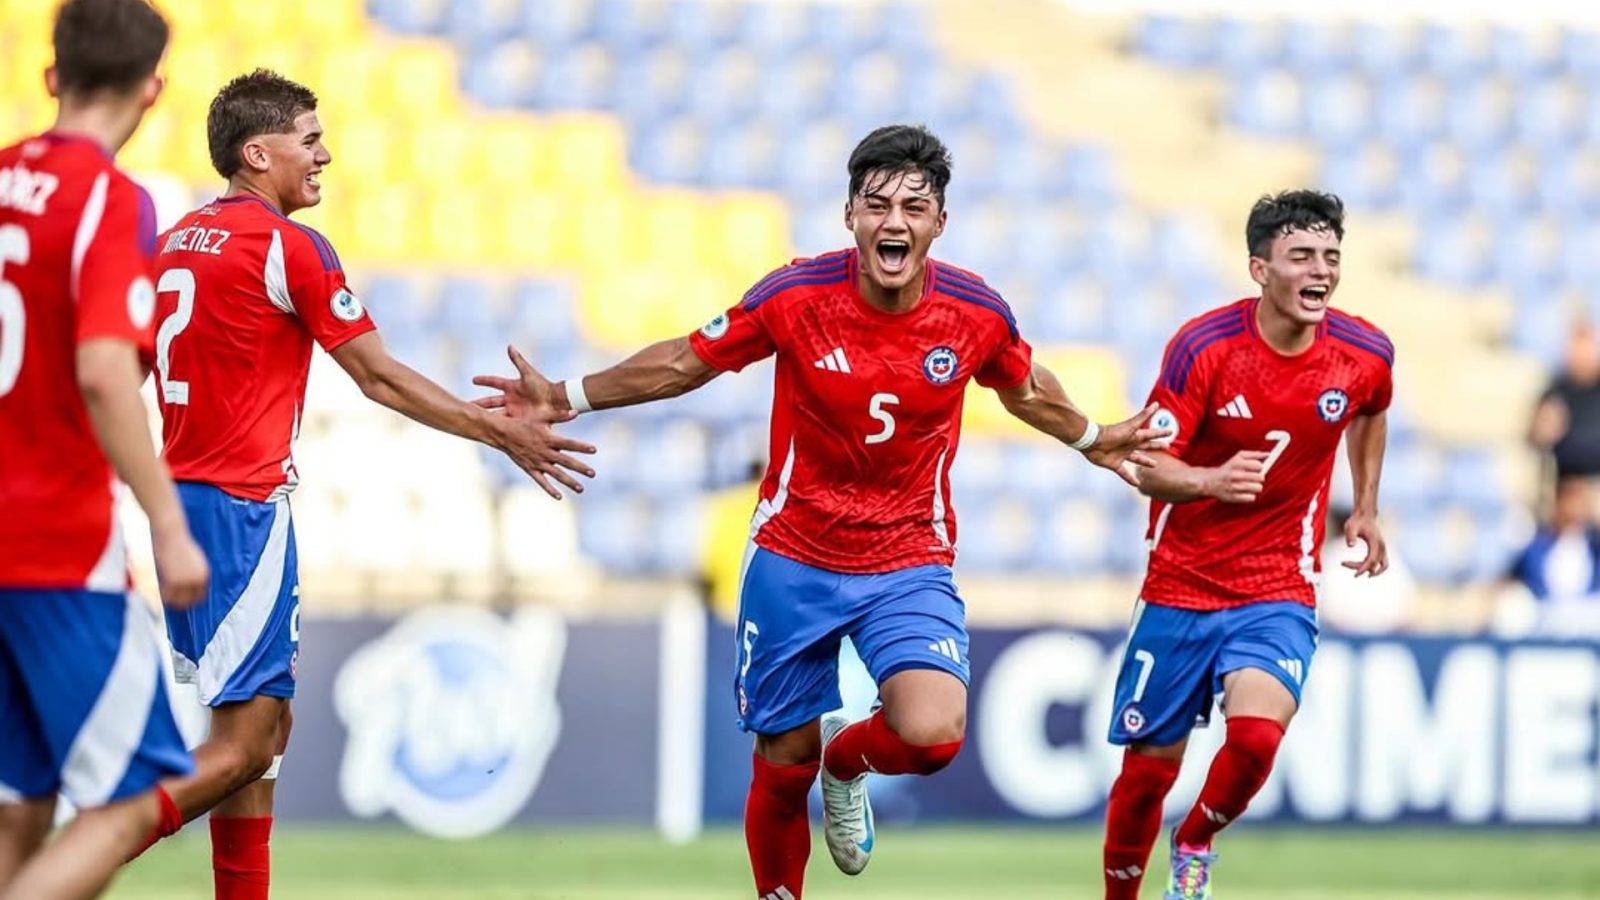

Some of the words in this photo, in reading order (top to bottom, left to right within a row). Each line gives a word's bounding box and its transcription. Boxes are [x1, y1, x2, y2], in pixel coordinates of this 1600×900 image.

[156, 267, 196, 406] 2
[865, 392, 900, 444] 5
[1262, 430, 1291, 476] 7
[741, 619, 760, 678] 5
[1133, 649, 1155, 702] 7
